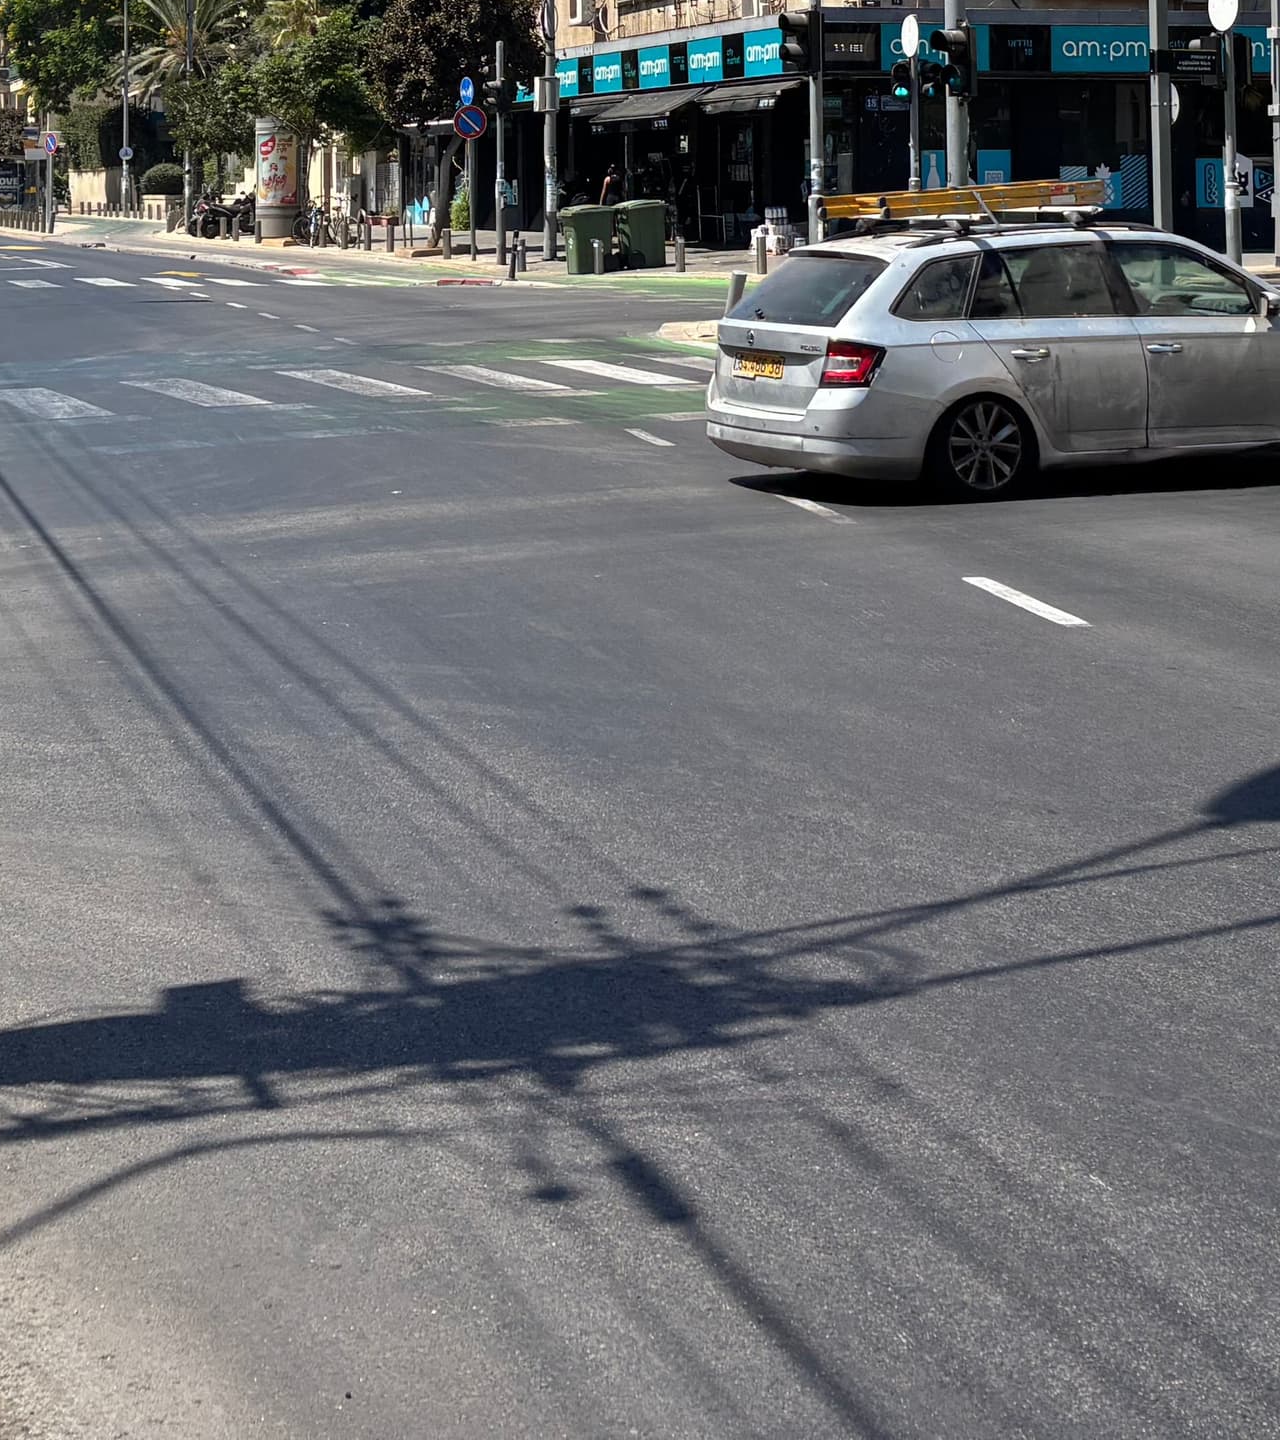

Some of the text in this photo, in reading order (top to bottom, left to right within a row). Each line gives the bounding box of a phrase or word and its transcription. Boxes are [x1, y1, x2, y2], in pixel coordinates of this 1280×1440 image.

[689, 51, 720, 71] am:pm
[746, 42, 780, 64] am:pm
[1062, 40, 1147, 62] am:pm
[595, 64, 620, 83] am:pm
[640, 58, 667, 77] am:pm
